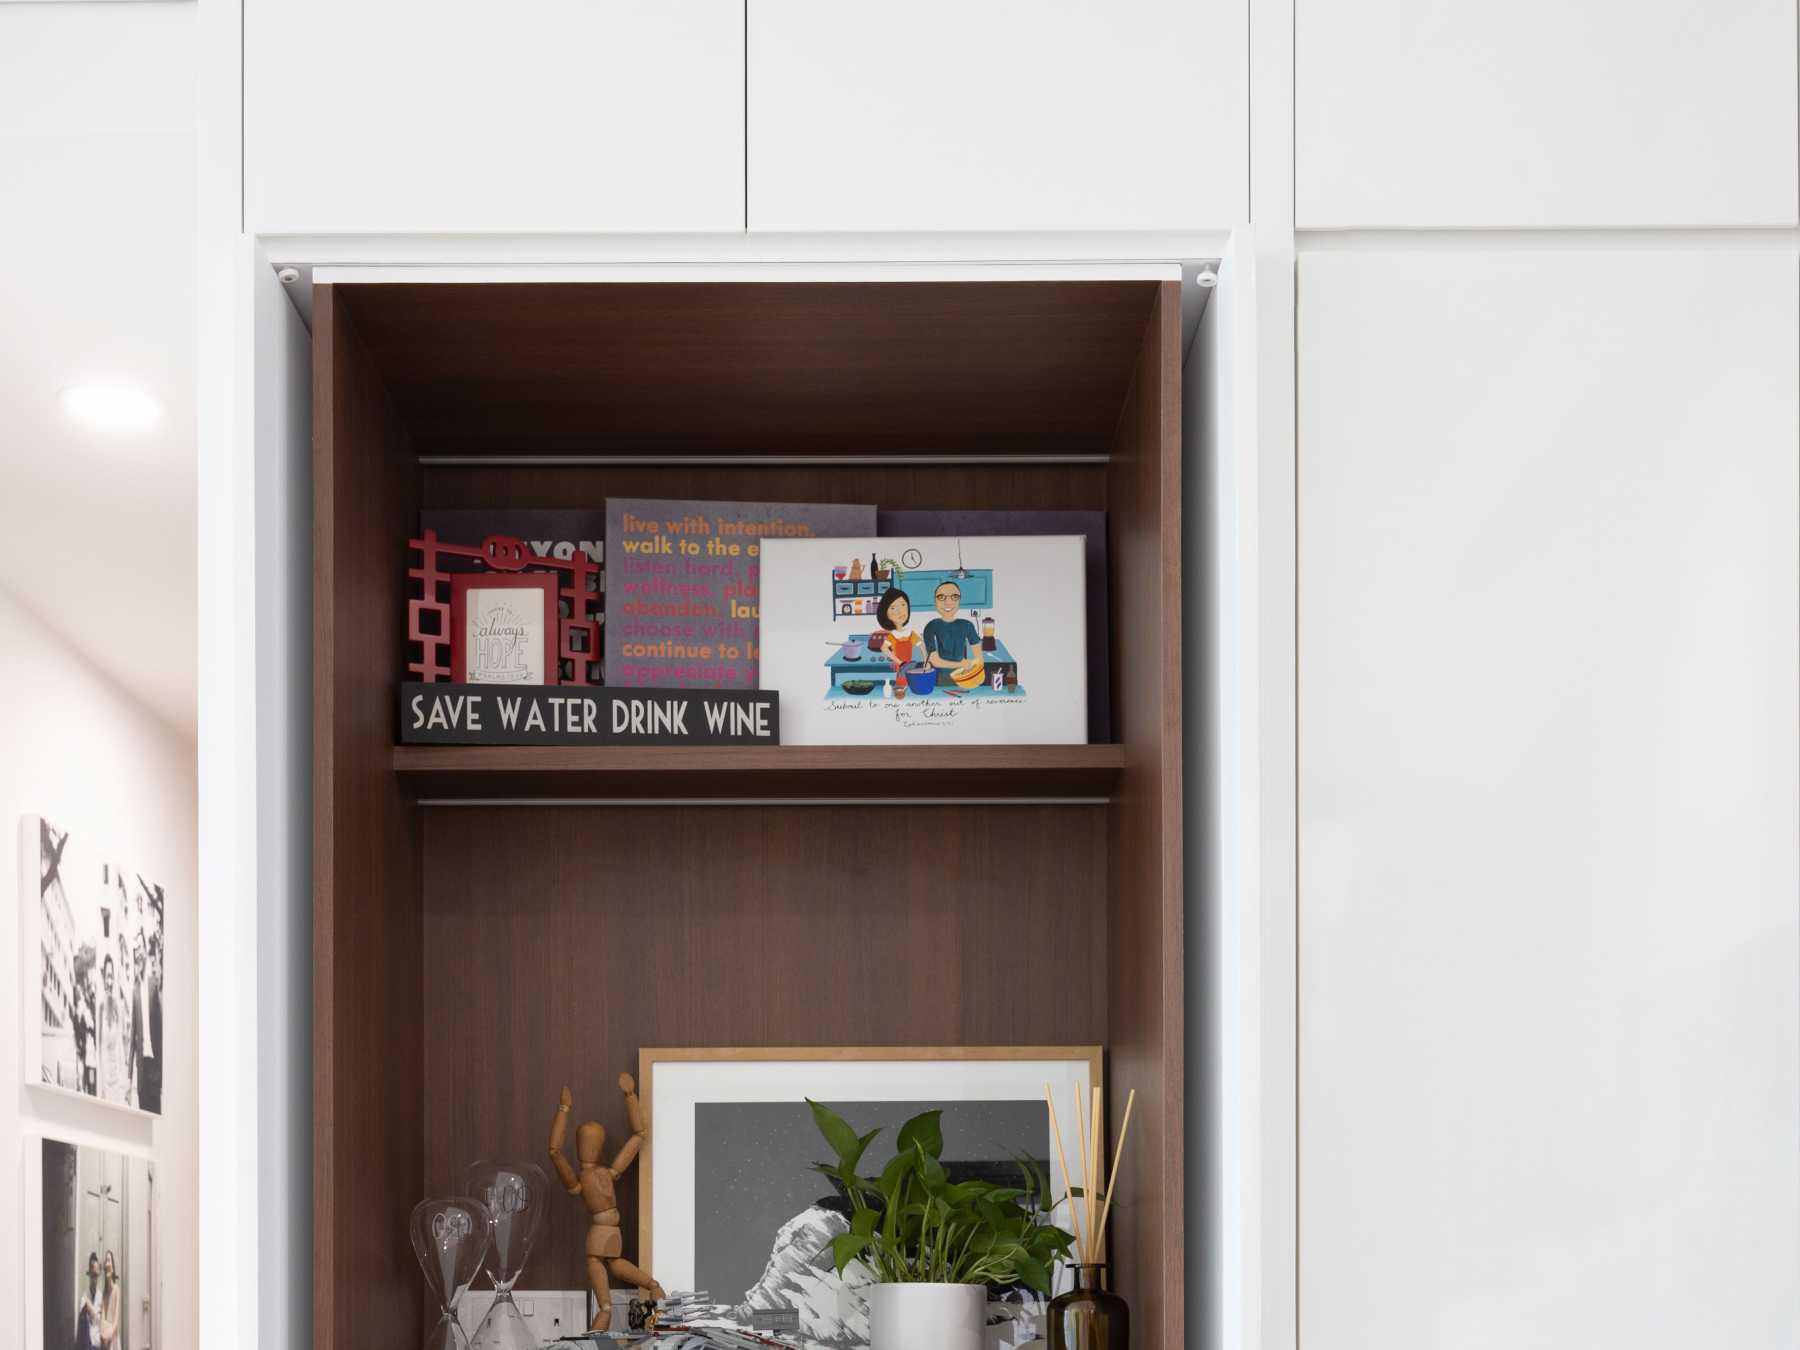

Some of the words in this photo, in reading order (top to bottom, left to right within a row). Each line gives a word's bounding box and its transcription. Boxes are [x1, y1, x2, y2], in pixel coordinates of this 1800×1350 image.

[623, 512, 660, 533] live
[666, 514, 711, 535] with
[623, 535, 672, 555] walk
[680, 539, 701, 556] to
[707, 537, 741, 557] the
[722, 578, 759, 599] pla
[730, 600, 759, 618] lau
[479, 616, 525, 651] always
[623, 622, 693, 638] choose
[703, 622, 746, 639] with
[477, 638, 528, 670] HOPE
[623, 640, 711, 659] continue
[718, 642, 738, 659] to
[623, 664, 736, 684] appreciate
[411, 695, 482, 731] SAVE
[497, 697, 598, 733] WATER
[612, 699, 688, 735] DRINK
[704, 701, 771, 737] WINE
[896, 709, 913, 722] for
[923, 708, 961, 718] Christ
